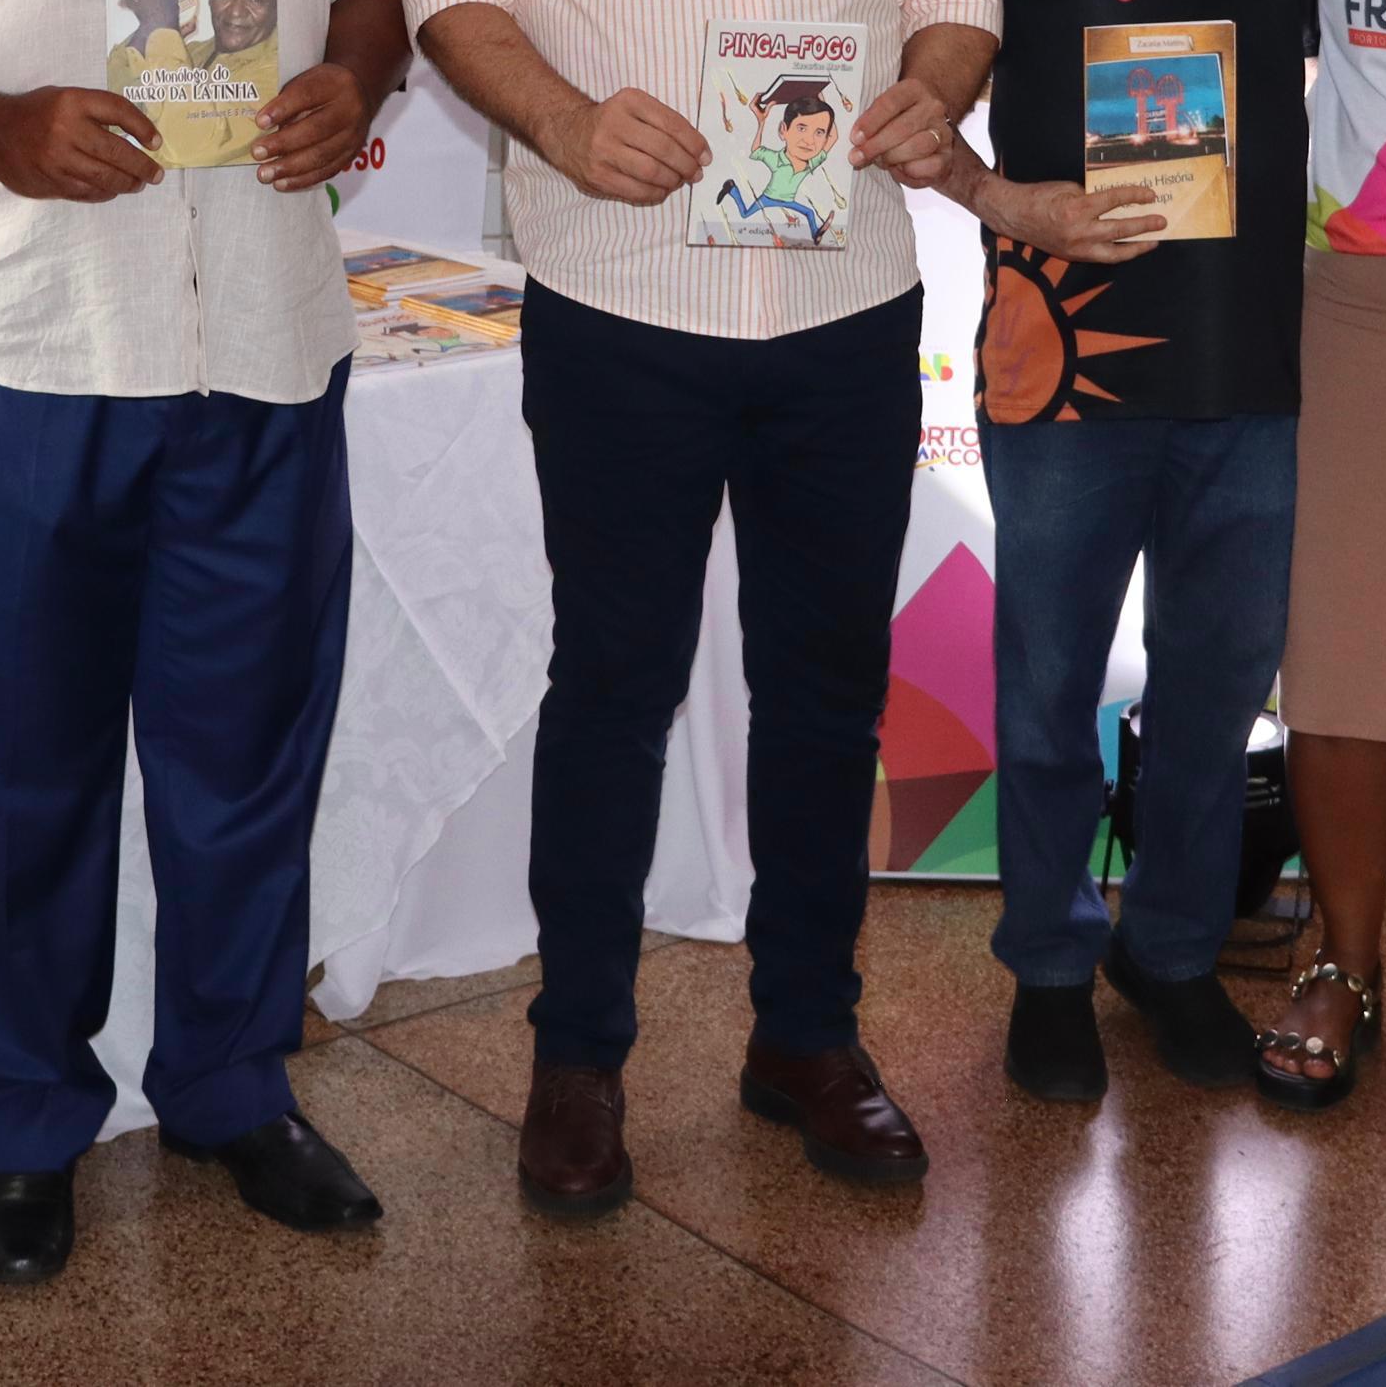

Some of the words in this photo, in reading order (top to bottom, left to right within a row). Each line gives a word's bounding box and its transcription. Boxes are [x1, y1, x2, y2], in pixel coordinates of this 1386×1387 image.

[719, 31, 857, 62] PINGA-FOGO
[155, 67, 207, 87] Monólogo
[213, 65, 229, 81] do
[124, 86, 164, 101] MAURO
[170, 86, 187, 101] DA
[193, 83, 258, 100] LATINHA
[1155, 172, 1195, 187] História
